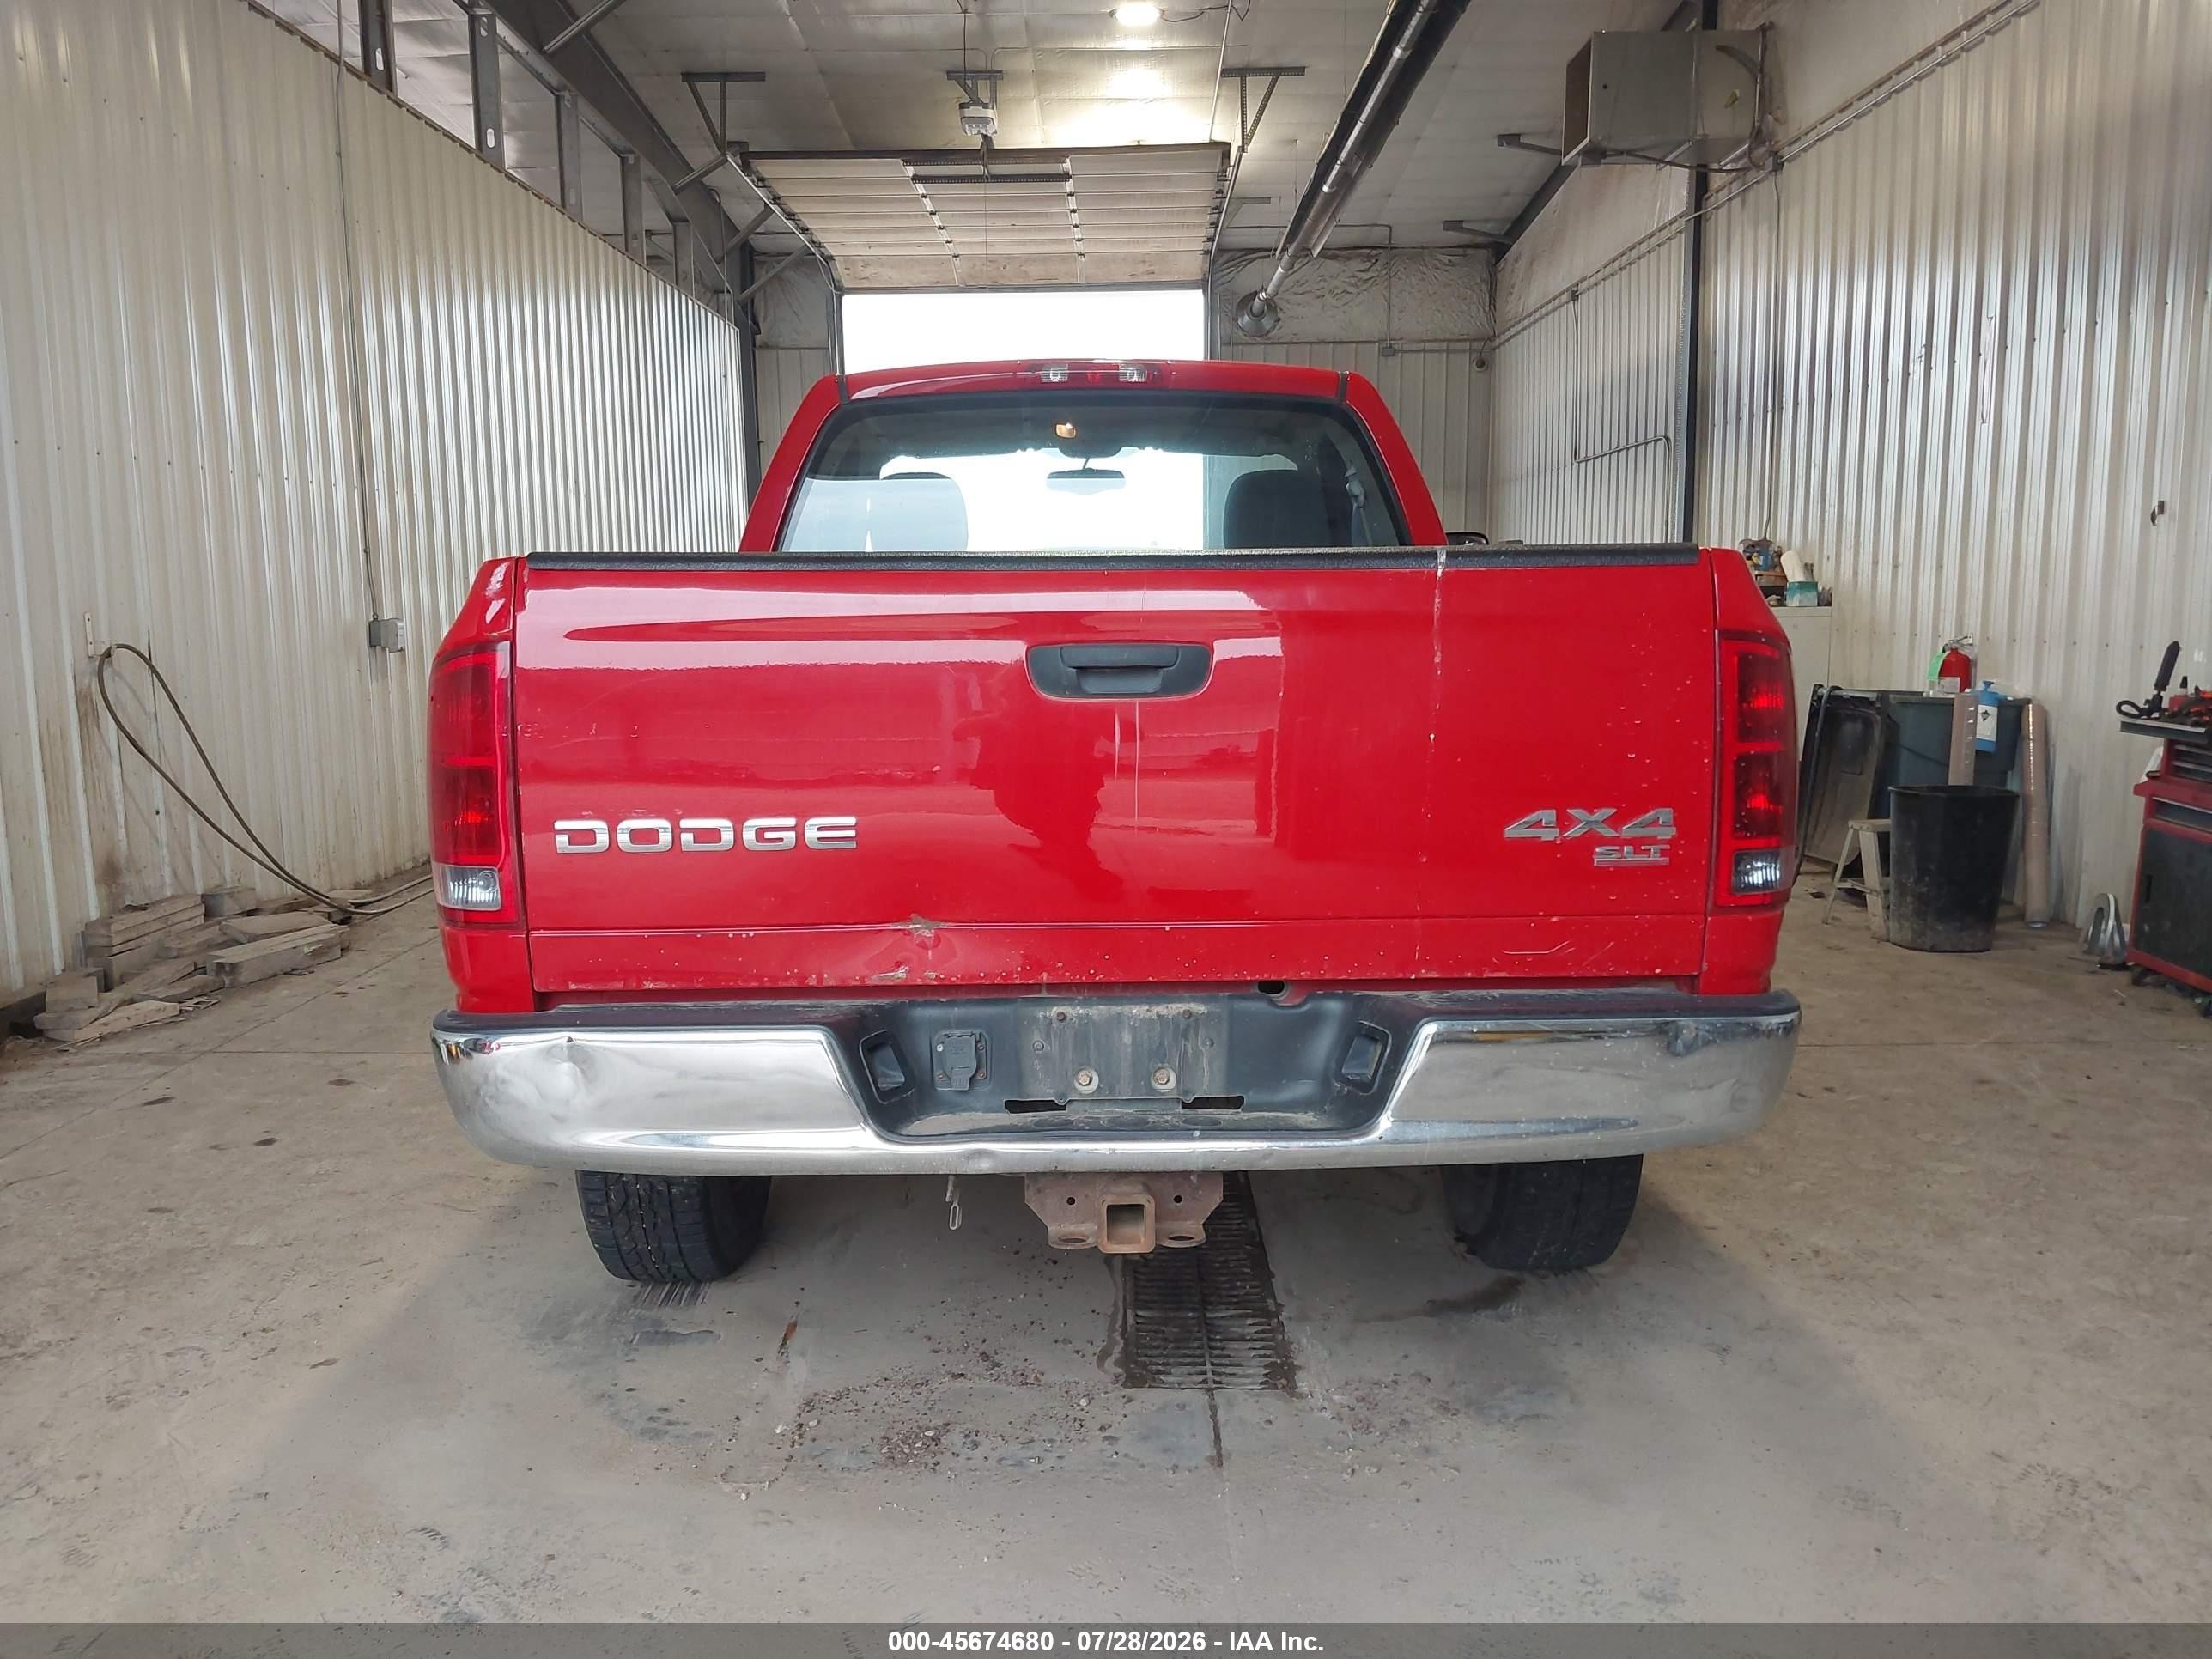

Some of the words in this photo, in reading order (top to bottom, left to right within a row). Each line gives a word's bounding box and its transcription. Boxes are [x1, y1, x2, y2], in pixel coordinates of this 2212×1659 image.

[554, 817, 858, 854] DODGE
[1504, 807, 1676, 841] 4X4
[1594, 844, 1670, 860] SLT
